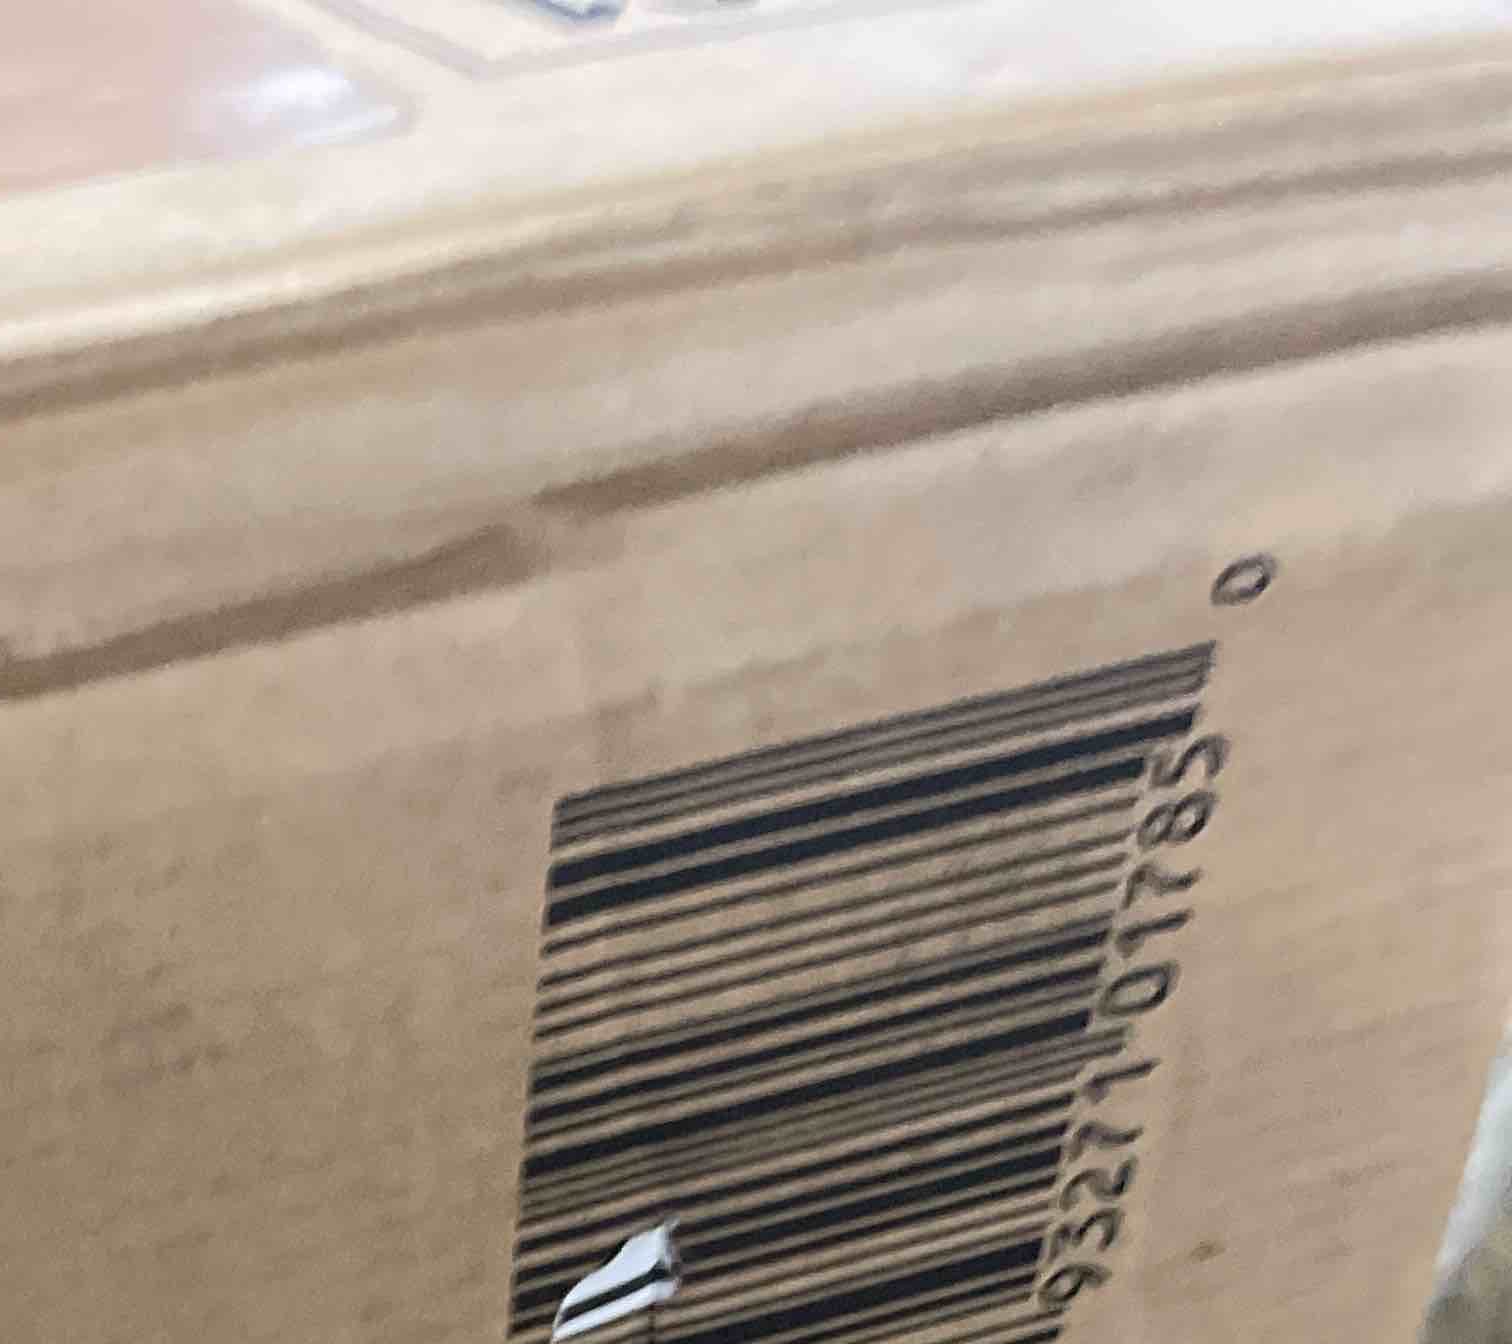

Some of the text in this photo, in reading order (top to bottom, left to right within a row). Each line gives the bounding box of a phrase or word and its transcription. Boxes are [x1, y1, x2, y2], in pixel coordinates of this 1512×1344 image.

[1210, 552, 1277, 606] 0
[1096, 732, 1229, 1016] 01785
[1035, 1056, 1162, 1313] 93271
